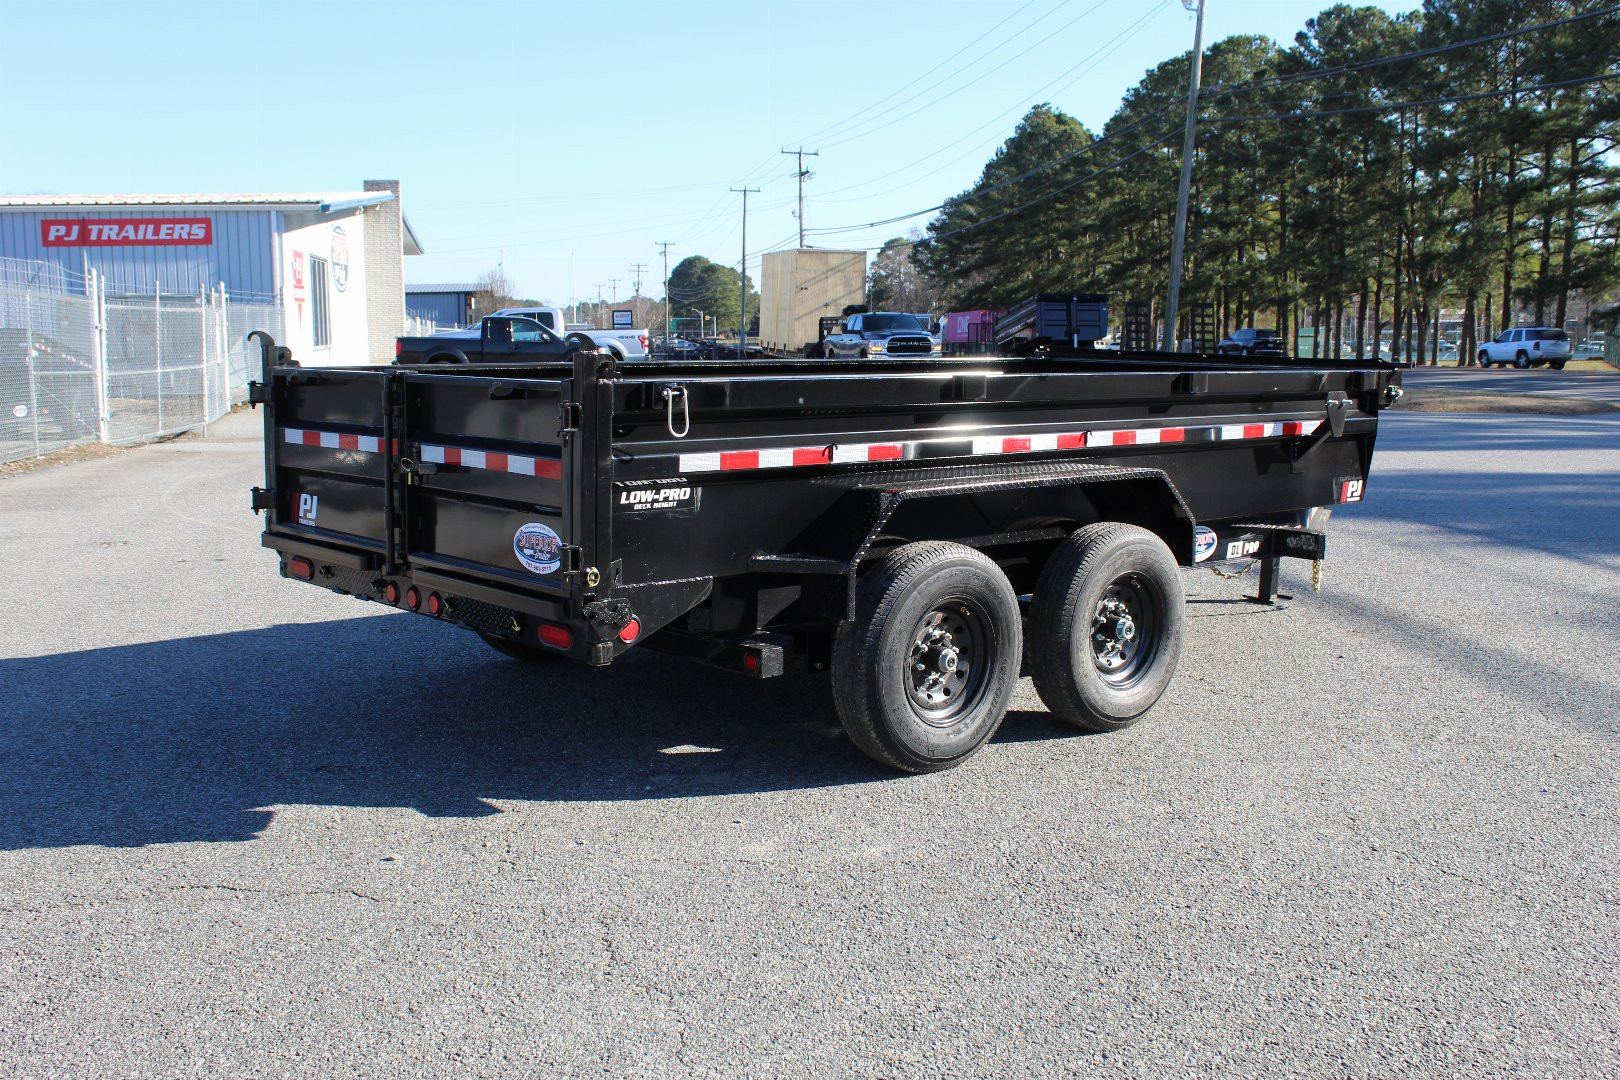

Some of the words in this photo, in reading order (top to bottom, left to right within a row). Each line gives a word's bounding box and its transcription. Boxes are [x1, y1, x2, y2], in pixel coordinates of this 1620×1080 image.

[48, 224, 81, 241] PJ
[87, 223, 207, 241] TRAILERS
[619, 487, 691, 505] LOW-PRO
[1347, 479, 1363, 498] PJ
[298, 493, 318, 520] PJ
[633, 502, 652, 510] DECK
[653, 500, 678, 509] HEIGHT
[519, 530, 559, 553] SUPERIOR
